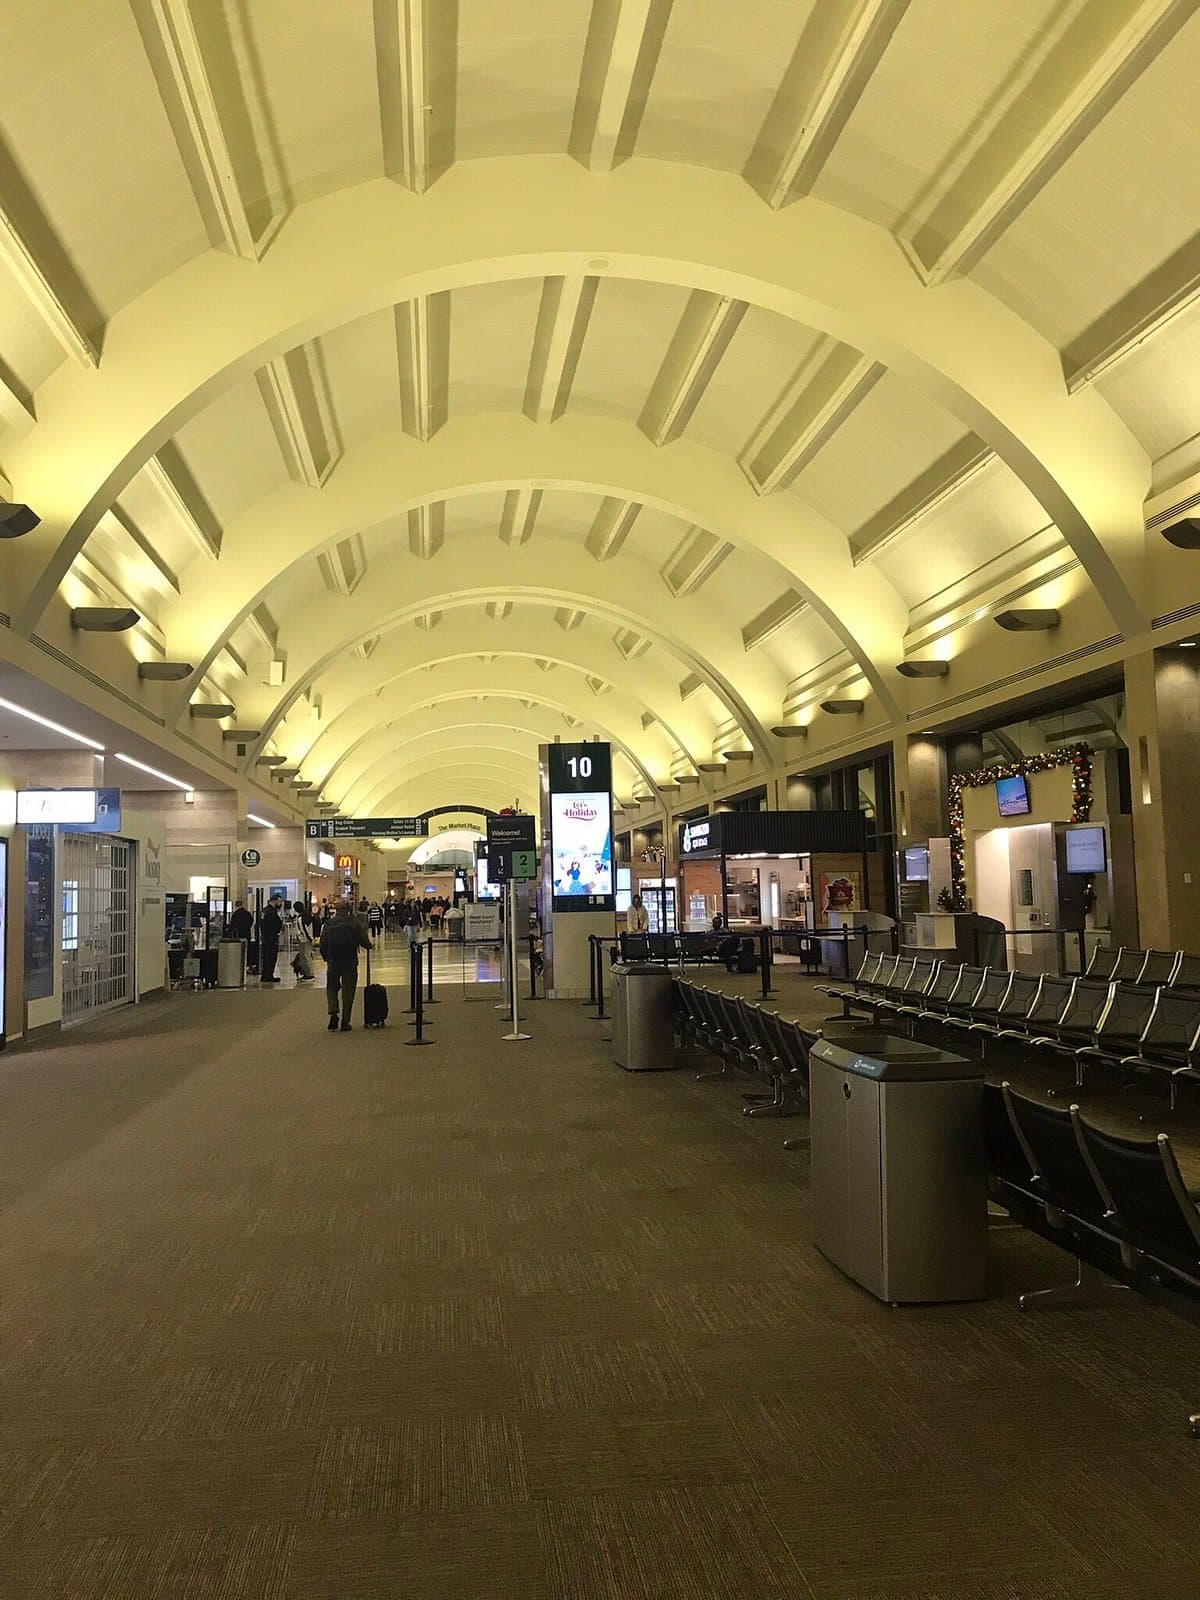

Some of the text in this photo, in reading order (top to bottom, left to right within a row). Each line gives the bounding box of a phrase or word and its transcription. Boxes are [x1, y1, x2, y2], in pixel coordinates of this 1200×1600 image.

[567, 756, 592, 778] 10
[563, 808, 598, 817] Holiday
[310, 825, 317, 835] B
[498, 855, 504, 867] 1
[520, 855, 528, 866] 2
